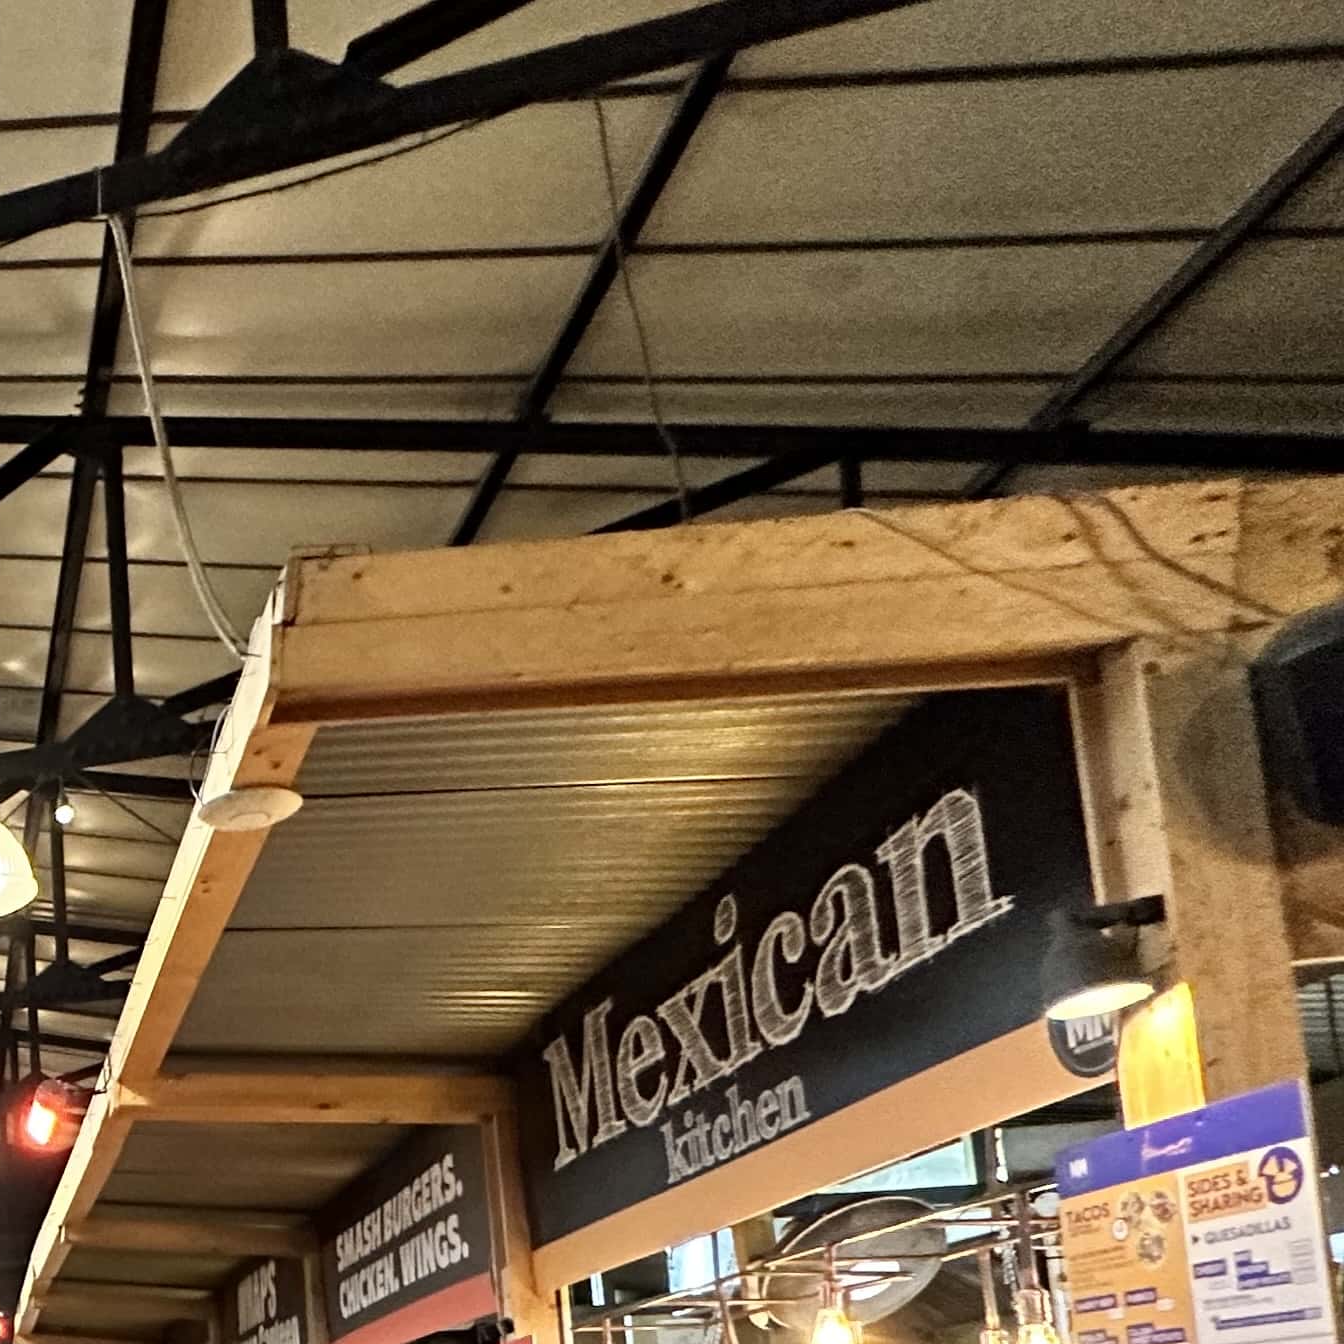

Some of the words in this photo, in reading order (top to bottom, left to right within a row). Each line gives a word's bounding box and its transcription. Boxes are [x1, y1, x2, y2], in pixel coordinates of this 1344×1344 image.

[542, 787, 1015, 1173] Mexican
[665, 1075, 810, 1184] kitchen
[336, 1206, 382, 1273] SMASH
[382, 1153, 464, 1243] BURGERS.
[1065, 1202, 1110, 1225] TACOS
[1188, 1174, 1232, 1197] SIDES
[1236, 1169, 1249, 1186] &
[1190, 1187, 1262, 1218] SHARING
[1204, 1216, 1292, 1244] QUESADILLAS
[339, 1262, 400, 1320] CHICKEN.
[399, 1214, 470, 1287] WINGS.
